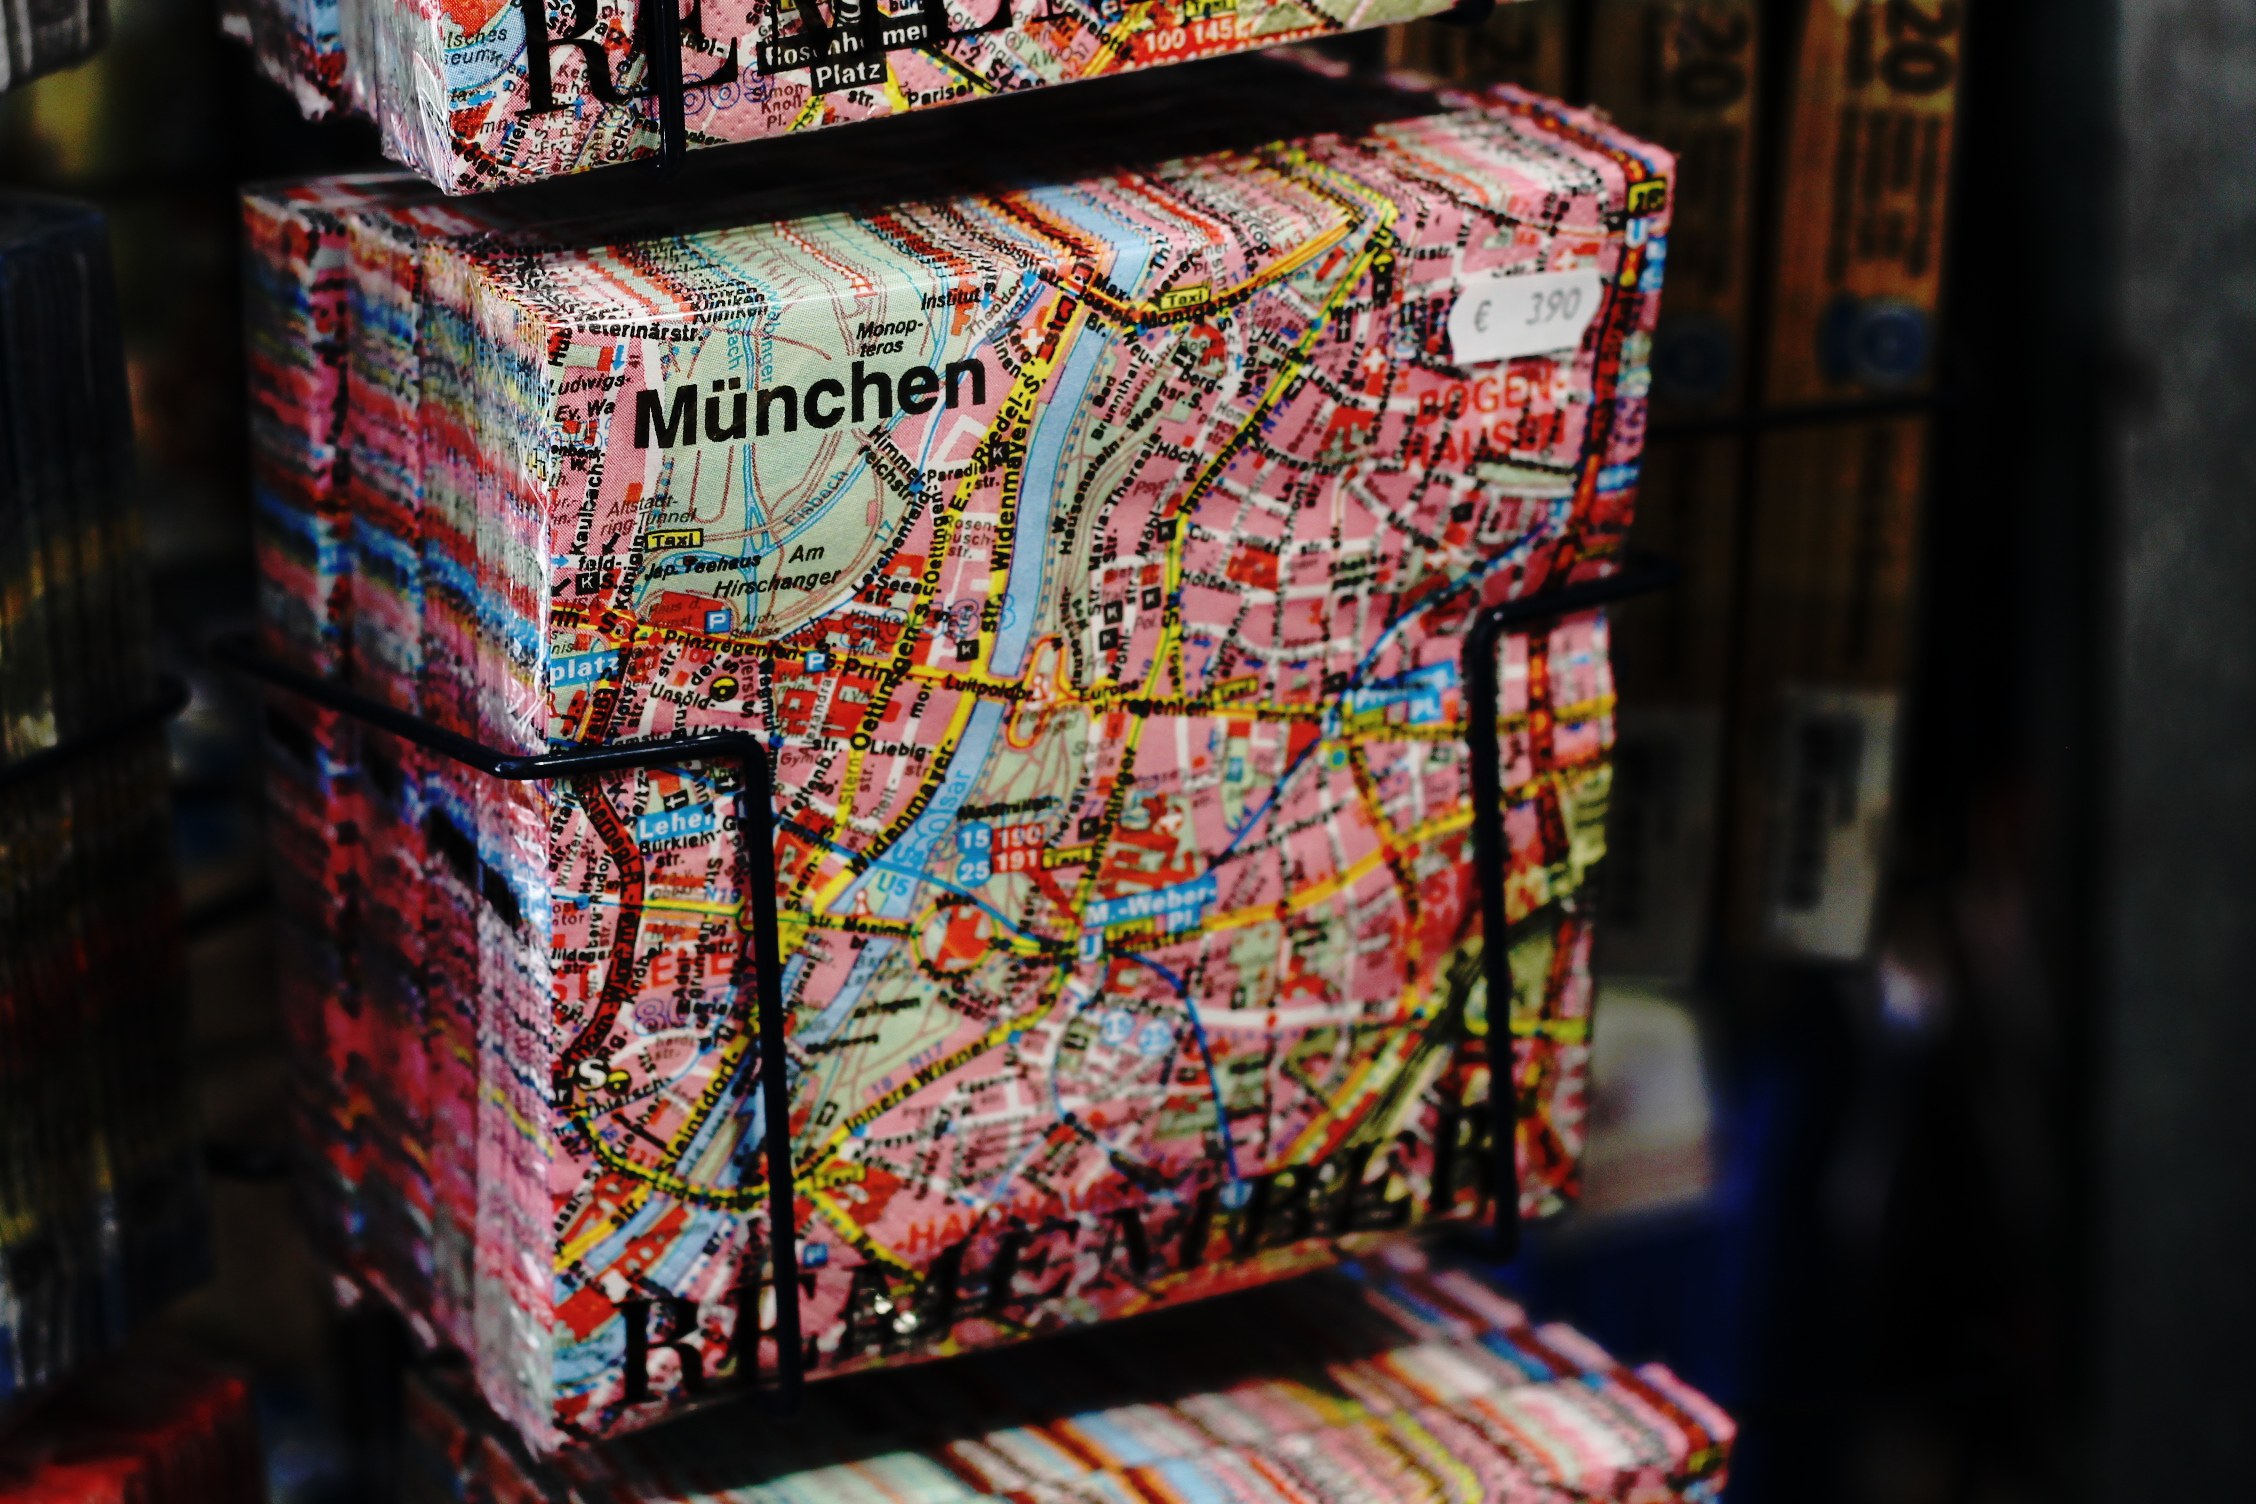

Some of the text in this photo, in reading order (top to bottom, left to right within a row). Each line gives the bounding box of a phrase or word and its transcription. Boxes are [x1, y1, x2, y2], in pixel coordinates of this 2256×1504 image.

[1144, 24, 1237, 54] 100 145
[816, 63, 881, 88] Platz
[1166, 290, 1205, 306] Taxi
[856, 319, 924, 340] Monop-
[860, 340, 904, 358] teros
[633, 357, 987, 450] München
[652, 533, 694, 547] Taxi
[788, 545, 825, 565] Am
[712, 569, 842, 598] Hirschanger
[708, 612, 728, 630] P
[551, 656, 620, 687] platz
[961, 829, 990, 849] 15
[960, 850, 1039, 881] 25 191
[877, 872, 910, 896] U5
